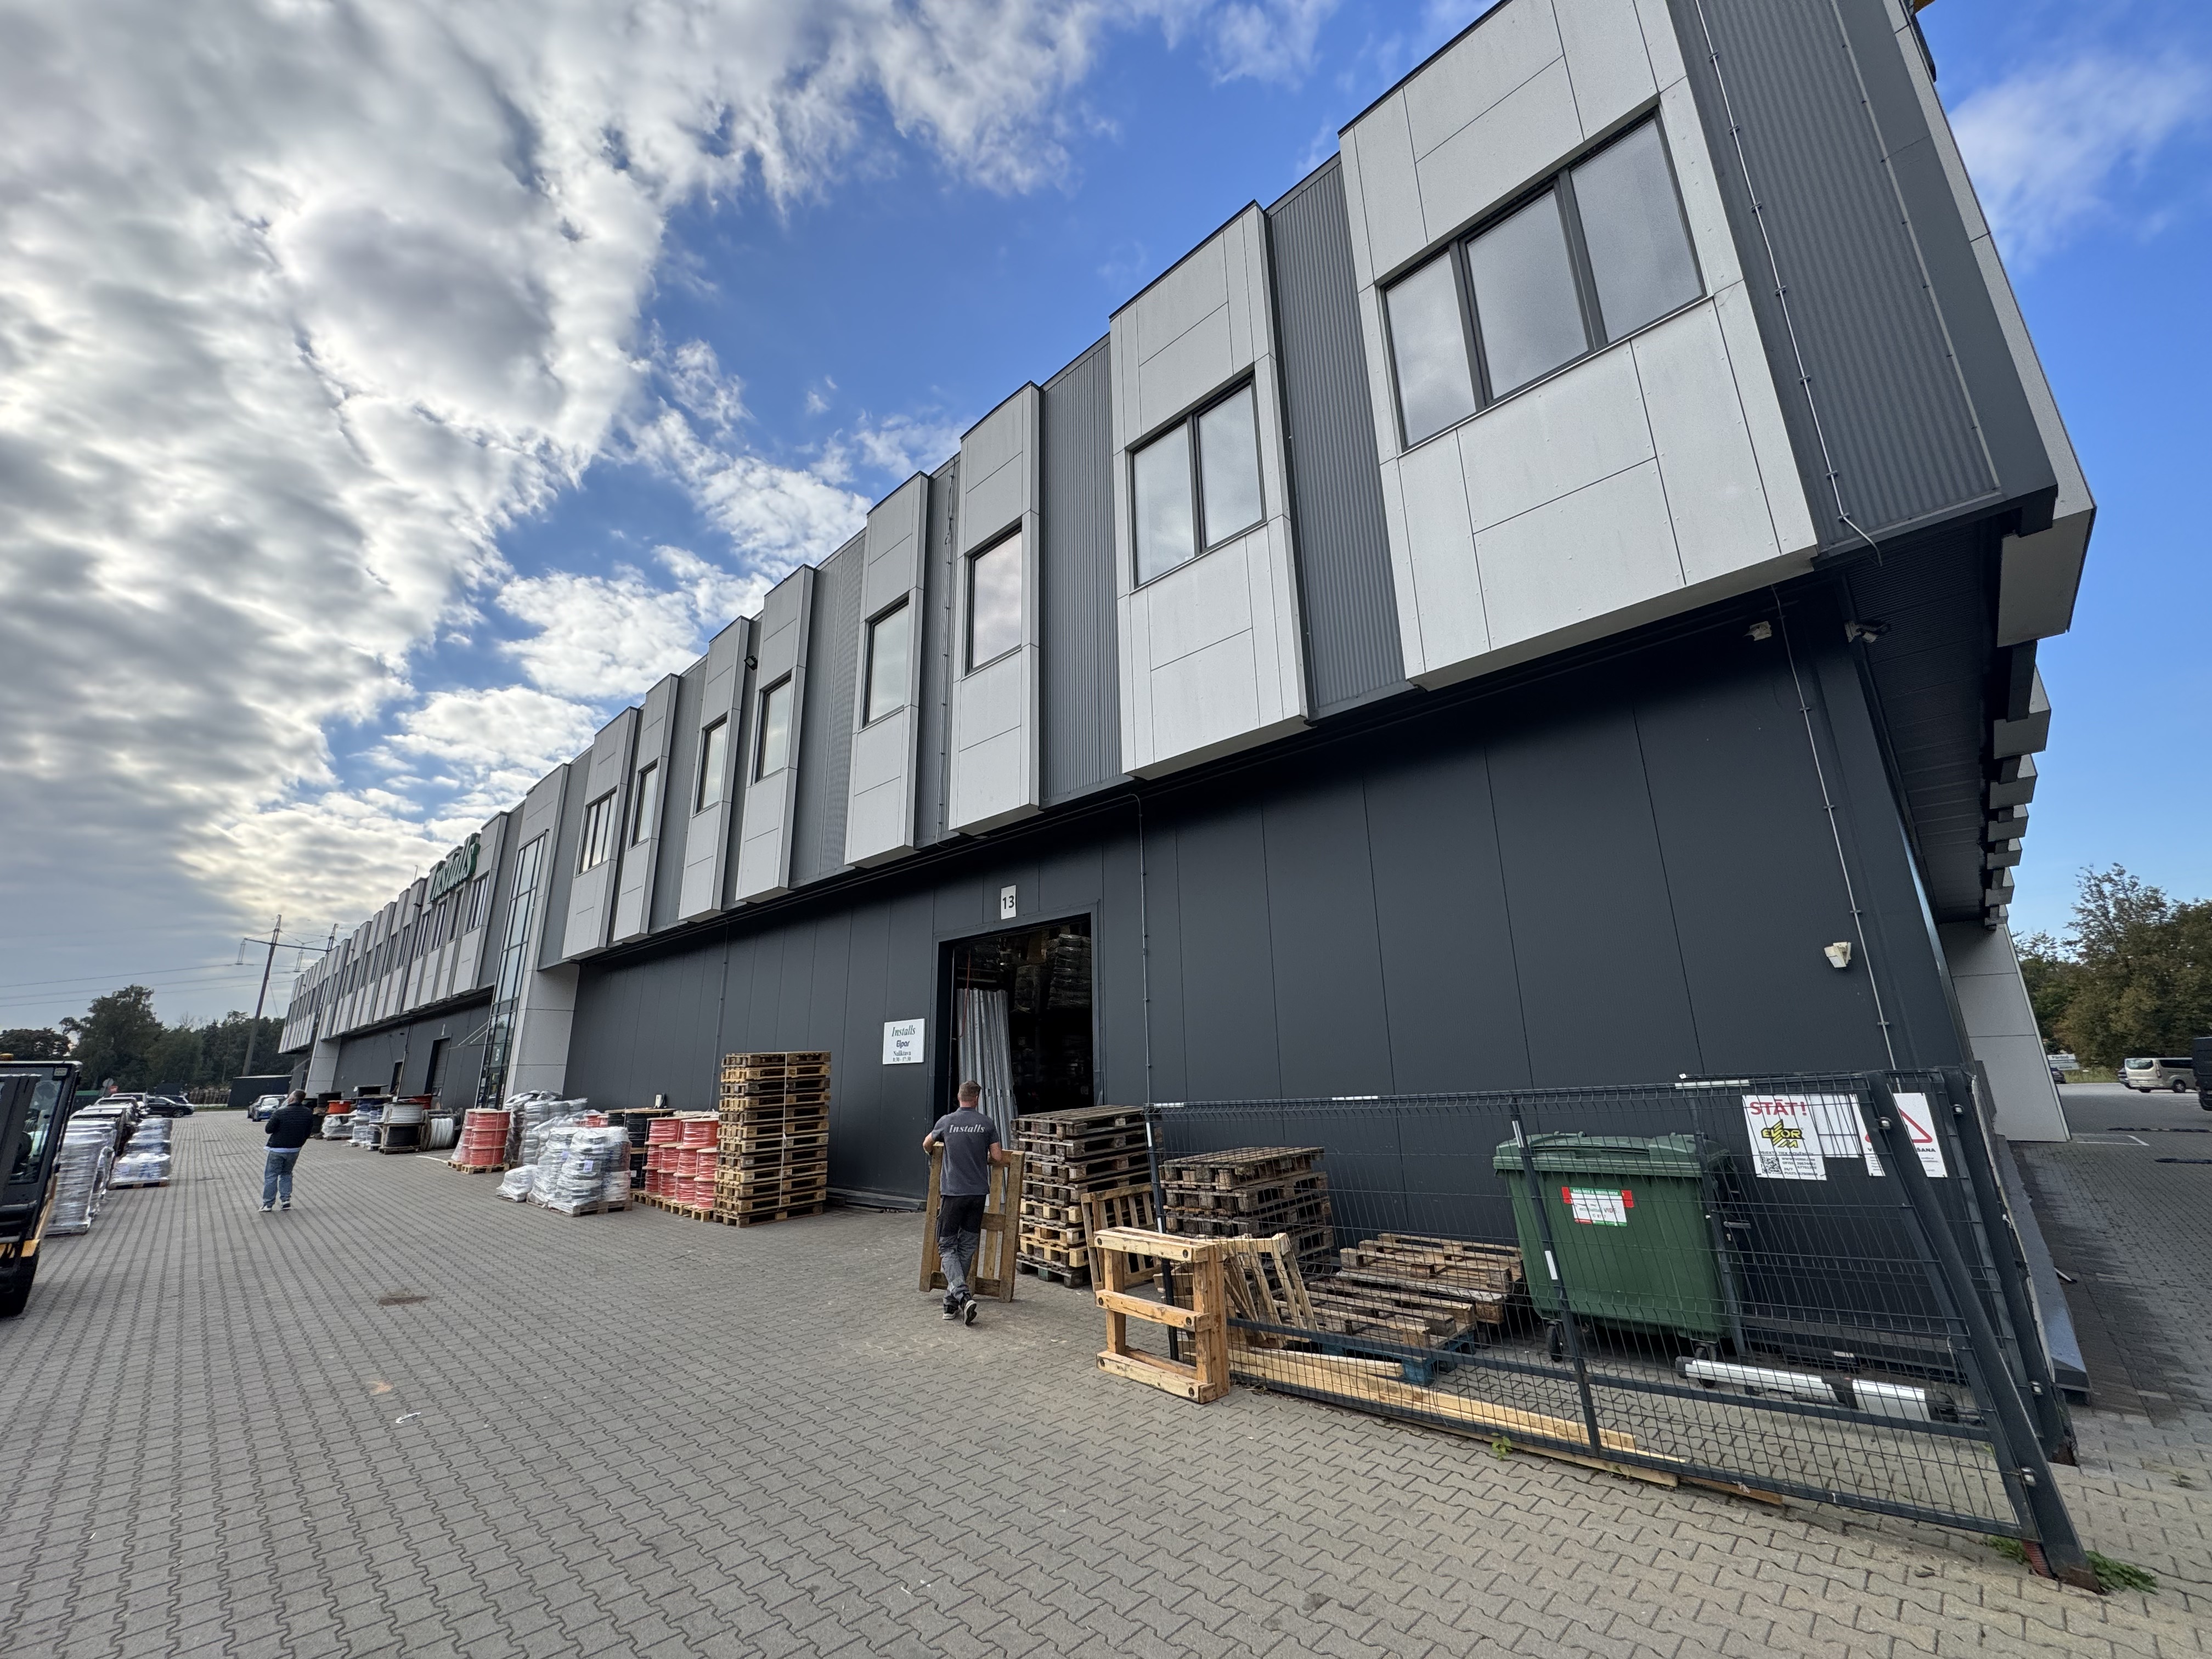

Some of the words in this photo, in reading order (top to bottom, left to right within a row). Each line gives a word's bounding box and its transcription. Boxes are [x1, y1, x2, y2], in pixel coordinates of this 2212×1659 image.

[1003, 895, 1014, 909] 13
[891, 1025, 916, 1037] Installs
[1750, 1099, 1807, 1116] STĀT!
[949, 1124, 985, 1133] Installs
